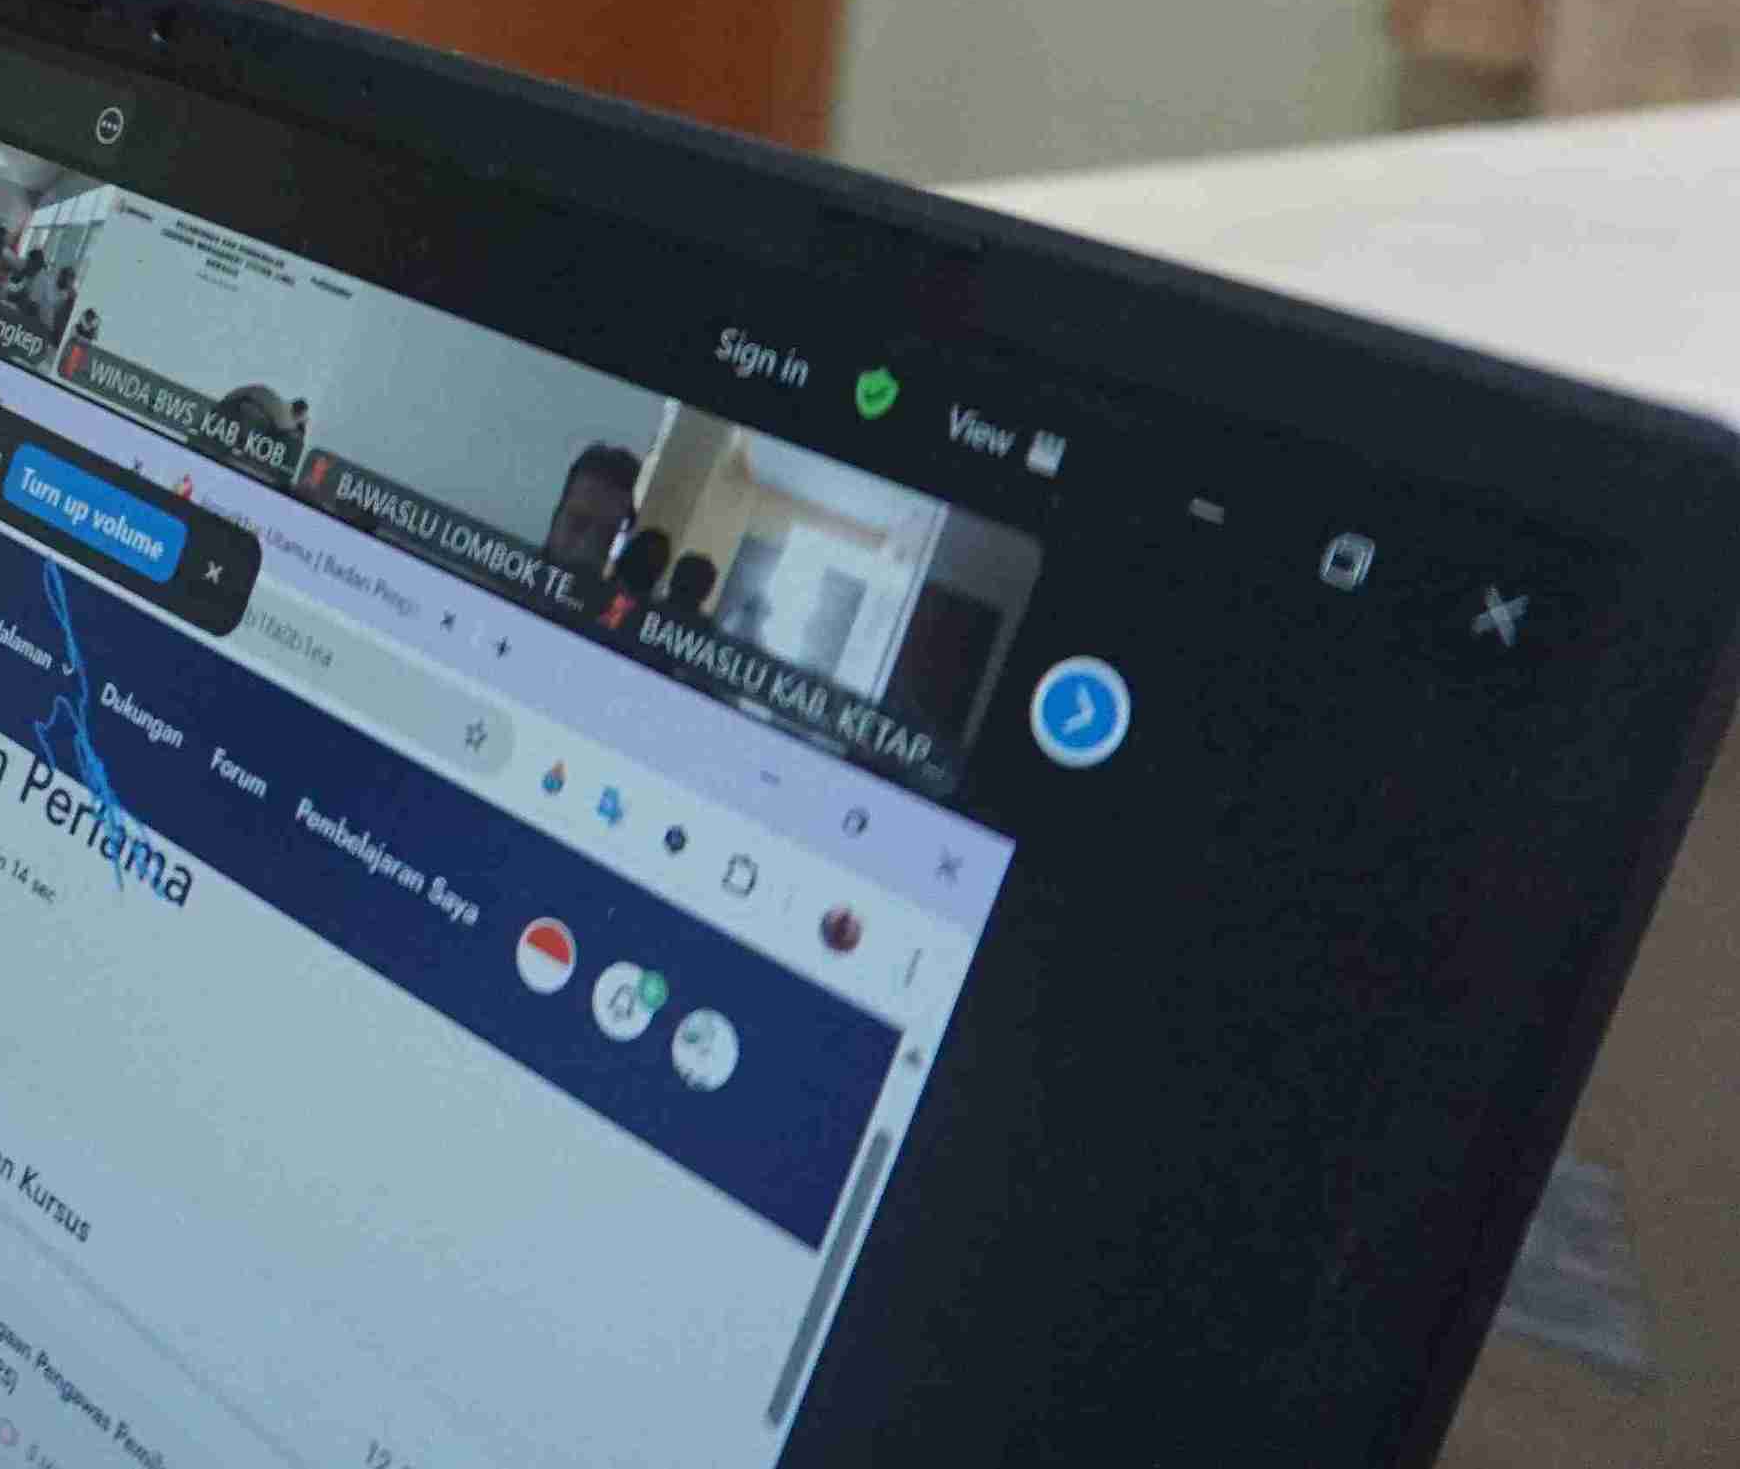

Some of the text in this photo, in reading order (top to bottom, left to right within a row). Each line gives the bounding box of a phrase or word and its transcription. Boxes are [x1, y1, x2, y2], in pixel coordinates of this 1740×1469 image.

[89, 358, 151, 405] WINDA
[716, 327, 810, 388] Sign in
[948, 402, 1017, 458] View
[22, 467, 61, 507] Turn
[61, 495, 91, 527] up
[91, 503, 164, 562] volume
[336, 471, 439, 538] BAWASLU
[439, 519, 543, 588] LOMBOK
[639, 609, 770, 694] BAWASLU
[100, 681, 184, 750] Dukungan
[210, 746, 268, 799] Forum
[10, 859, 29, 884] 14
[31, 879, 57, 904] sec
[294, 796, 482, 927] Pembelajaran Saya
[17, 1164, 93, 1243] Kursus
[33, 1349, 112, 1433] Pengawas
